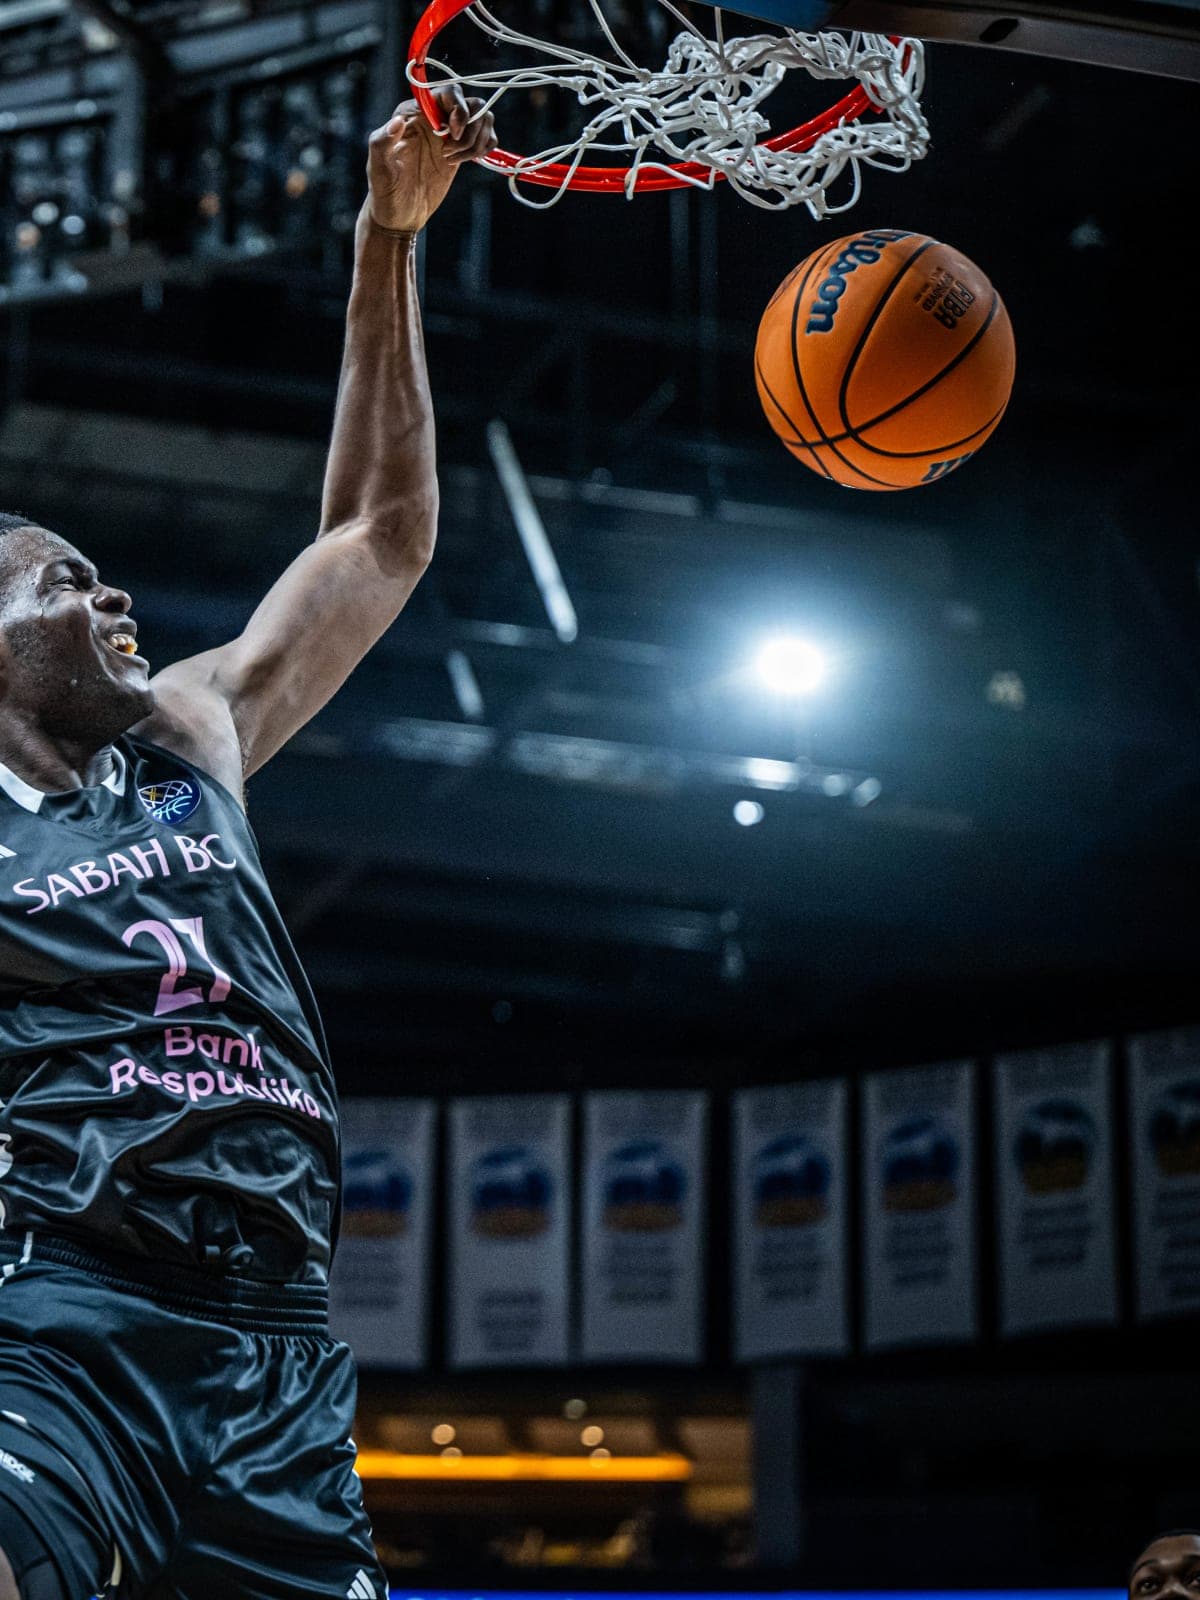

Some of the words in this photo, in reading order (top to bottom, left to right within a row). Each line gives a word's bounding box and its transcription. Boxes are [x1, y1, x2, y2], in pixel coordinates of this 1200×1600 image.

[12, 838, 171, 915] SABAH
[174, 833, 237, 873] BC
[121, 915, 232, 1017] 21
[164, 1026, 264, 1071] Bank
[109, 1057, 321, 1119] Respublika
